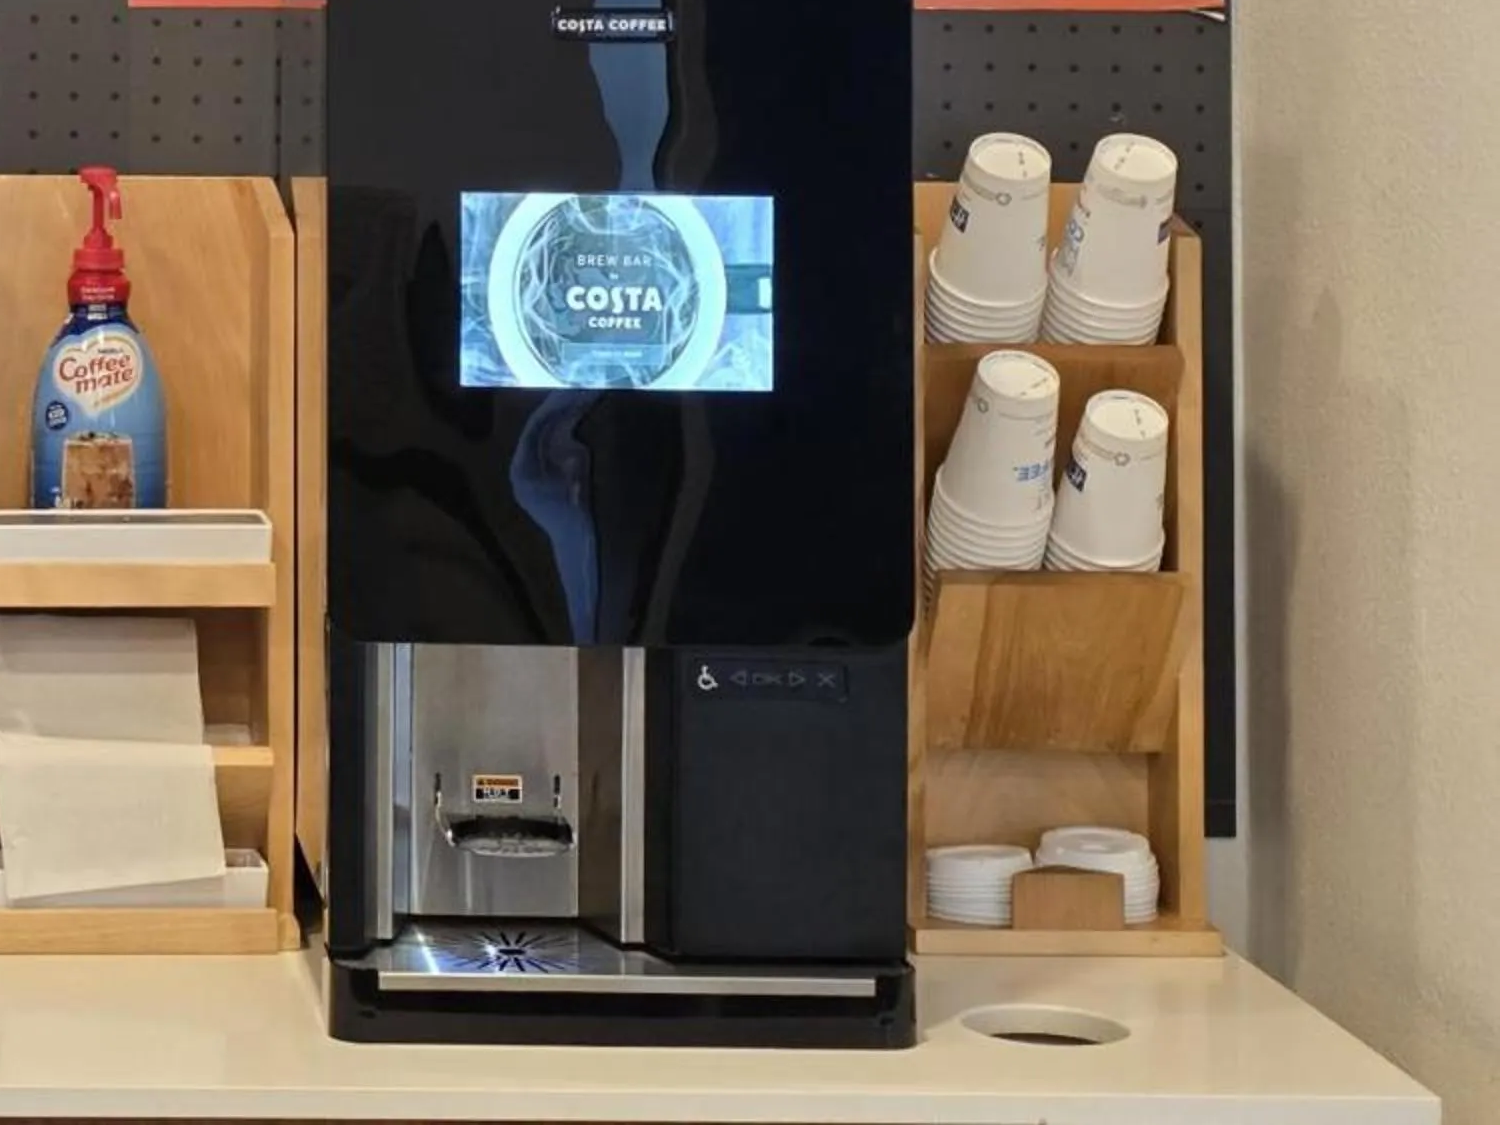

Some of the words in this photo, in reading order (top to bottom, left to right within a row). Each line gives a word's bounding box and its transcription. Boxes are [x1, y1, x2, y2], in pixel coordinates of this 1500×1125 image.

[557, 18, 605, 33] COSTA
[609, 18, 667, 32] COFFEE
[577, 254, 618, 267] BREW
[623, 254, 652, 267] BAR
[565, 286, 664, 314] COSTA
[588, 316, 642, 330] COFFEE
[59, 353, 131, 382] Coffee
[75, 367, 134, 396] mate
